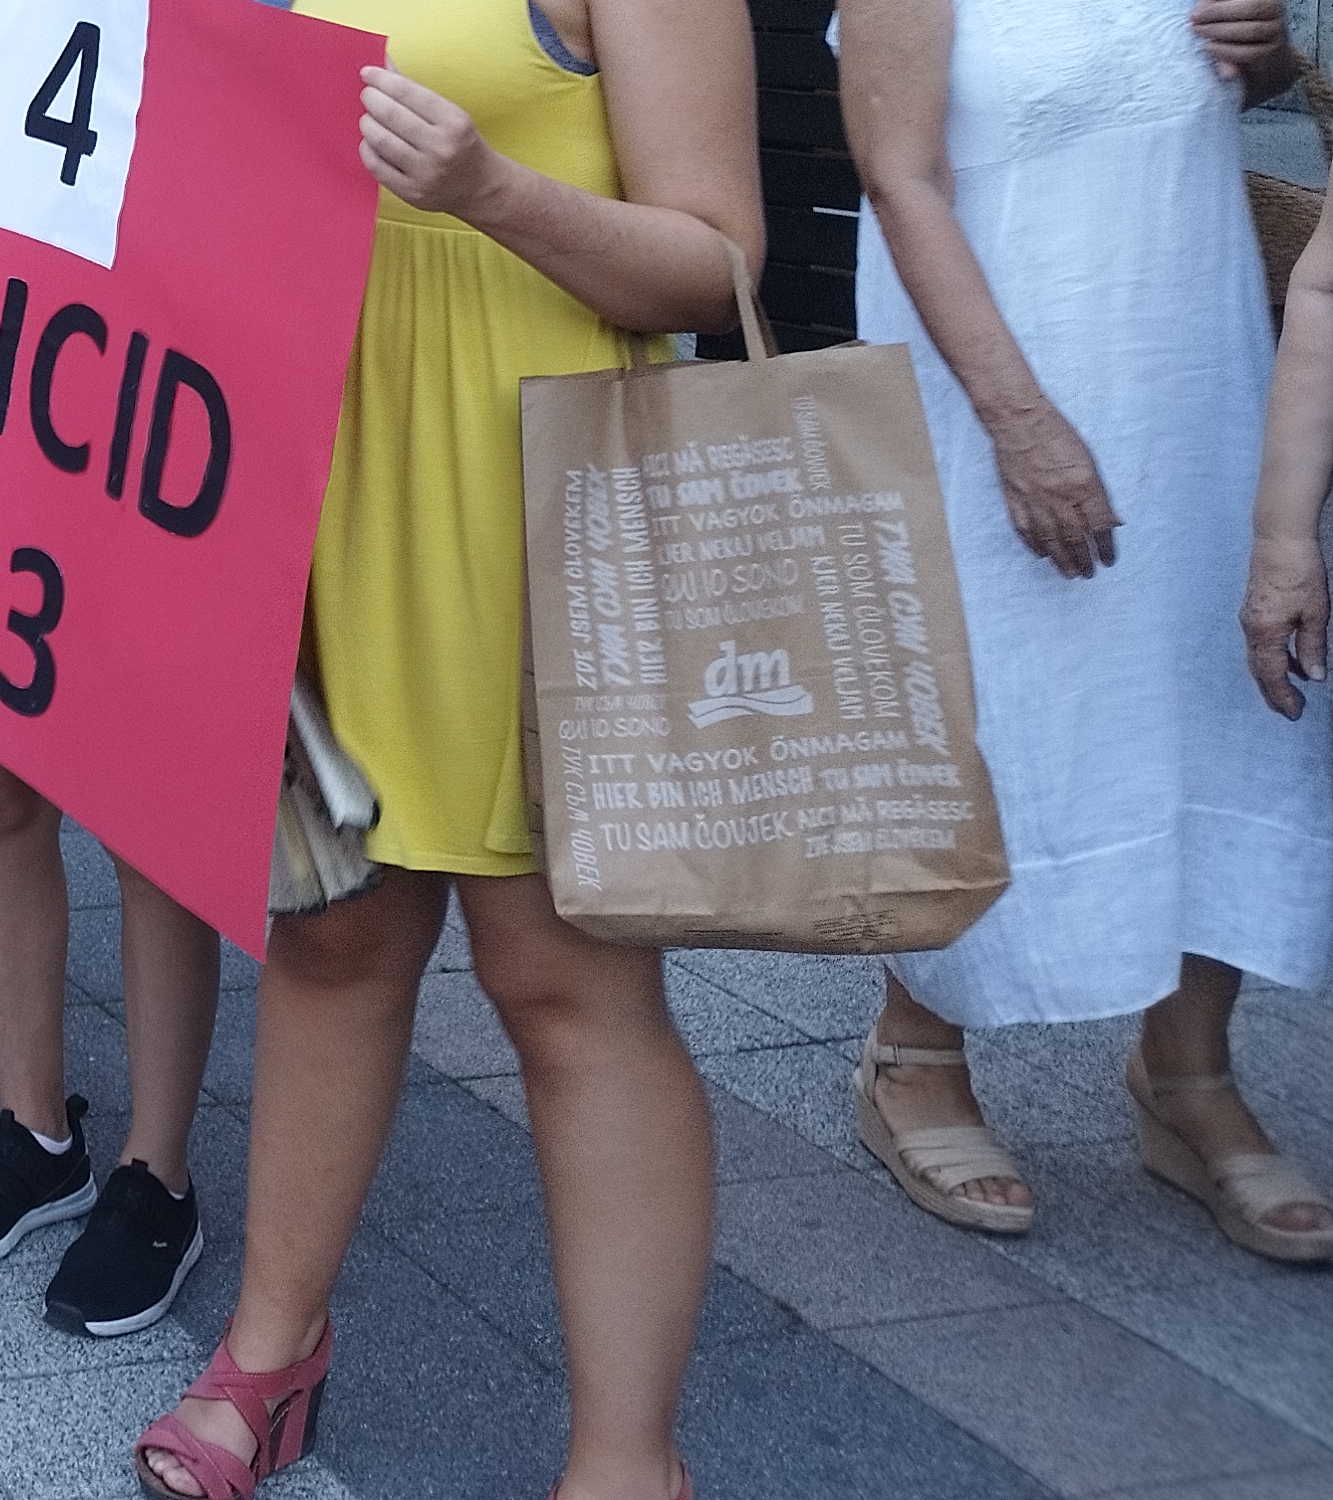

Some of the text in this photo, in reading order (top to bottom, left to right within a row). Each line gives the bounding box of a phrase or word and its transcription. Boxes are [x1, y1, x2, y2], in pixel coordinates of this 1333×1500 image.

[688, 504, 779, 532] VAGYOK
[611, 467, 667, 684] HIER BIN ICH MENSCH
[566, 585, 593, 643] JSEM
[838, 522, 901, 718] TU SOM ČLOVEKOM
[573, 648, 597, 692] ZDE
[703, 640, 791, 696] dm
[832, 657, 864, 720] VELJAM
[612, 716, 671, 737] SONO
[588, 730, 910, 774] ITT VAGYOK ÖNMAGAM
[592, 766, 814, 810] HIER BIN ICH MENSCH
[600, 811, 793, 852] TU SAM ČOVJEK
[571, 828, 603, 891] ЧОВЕК
